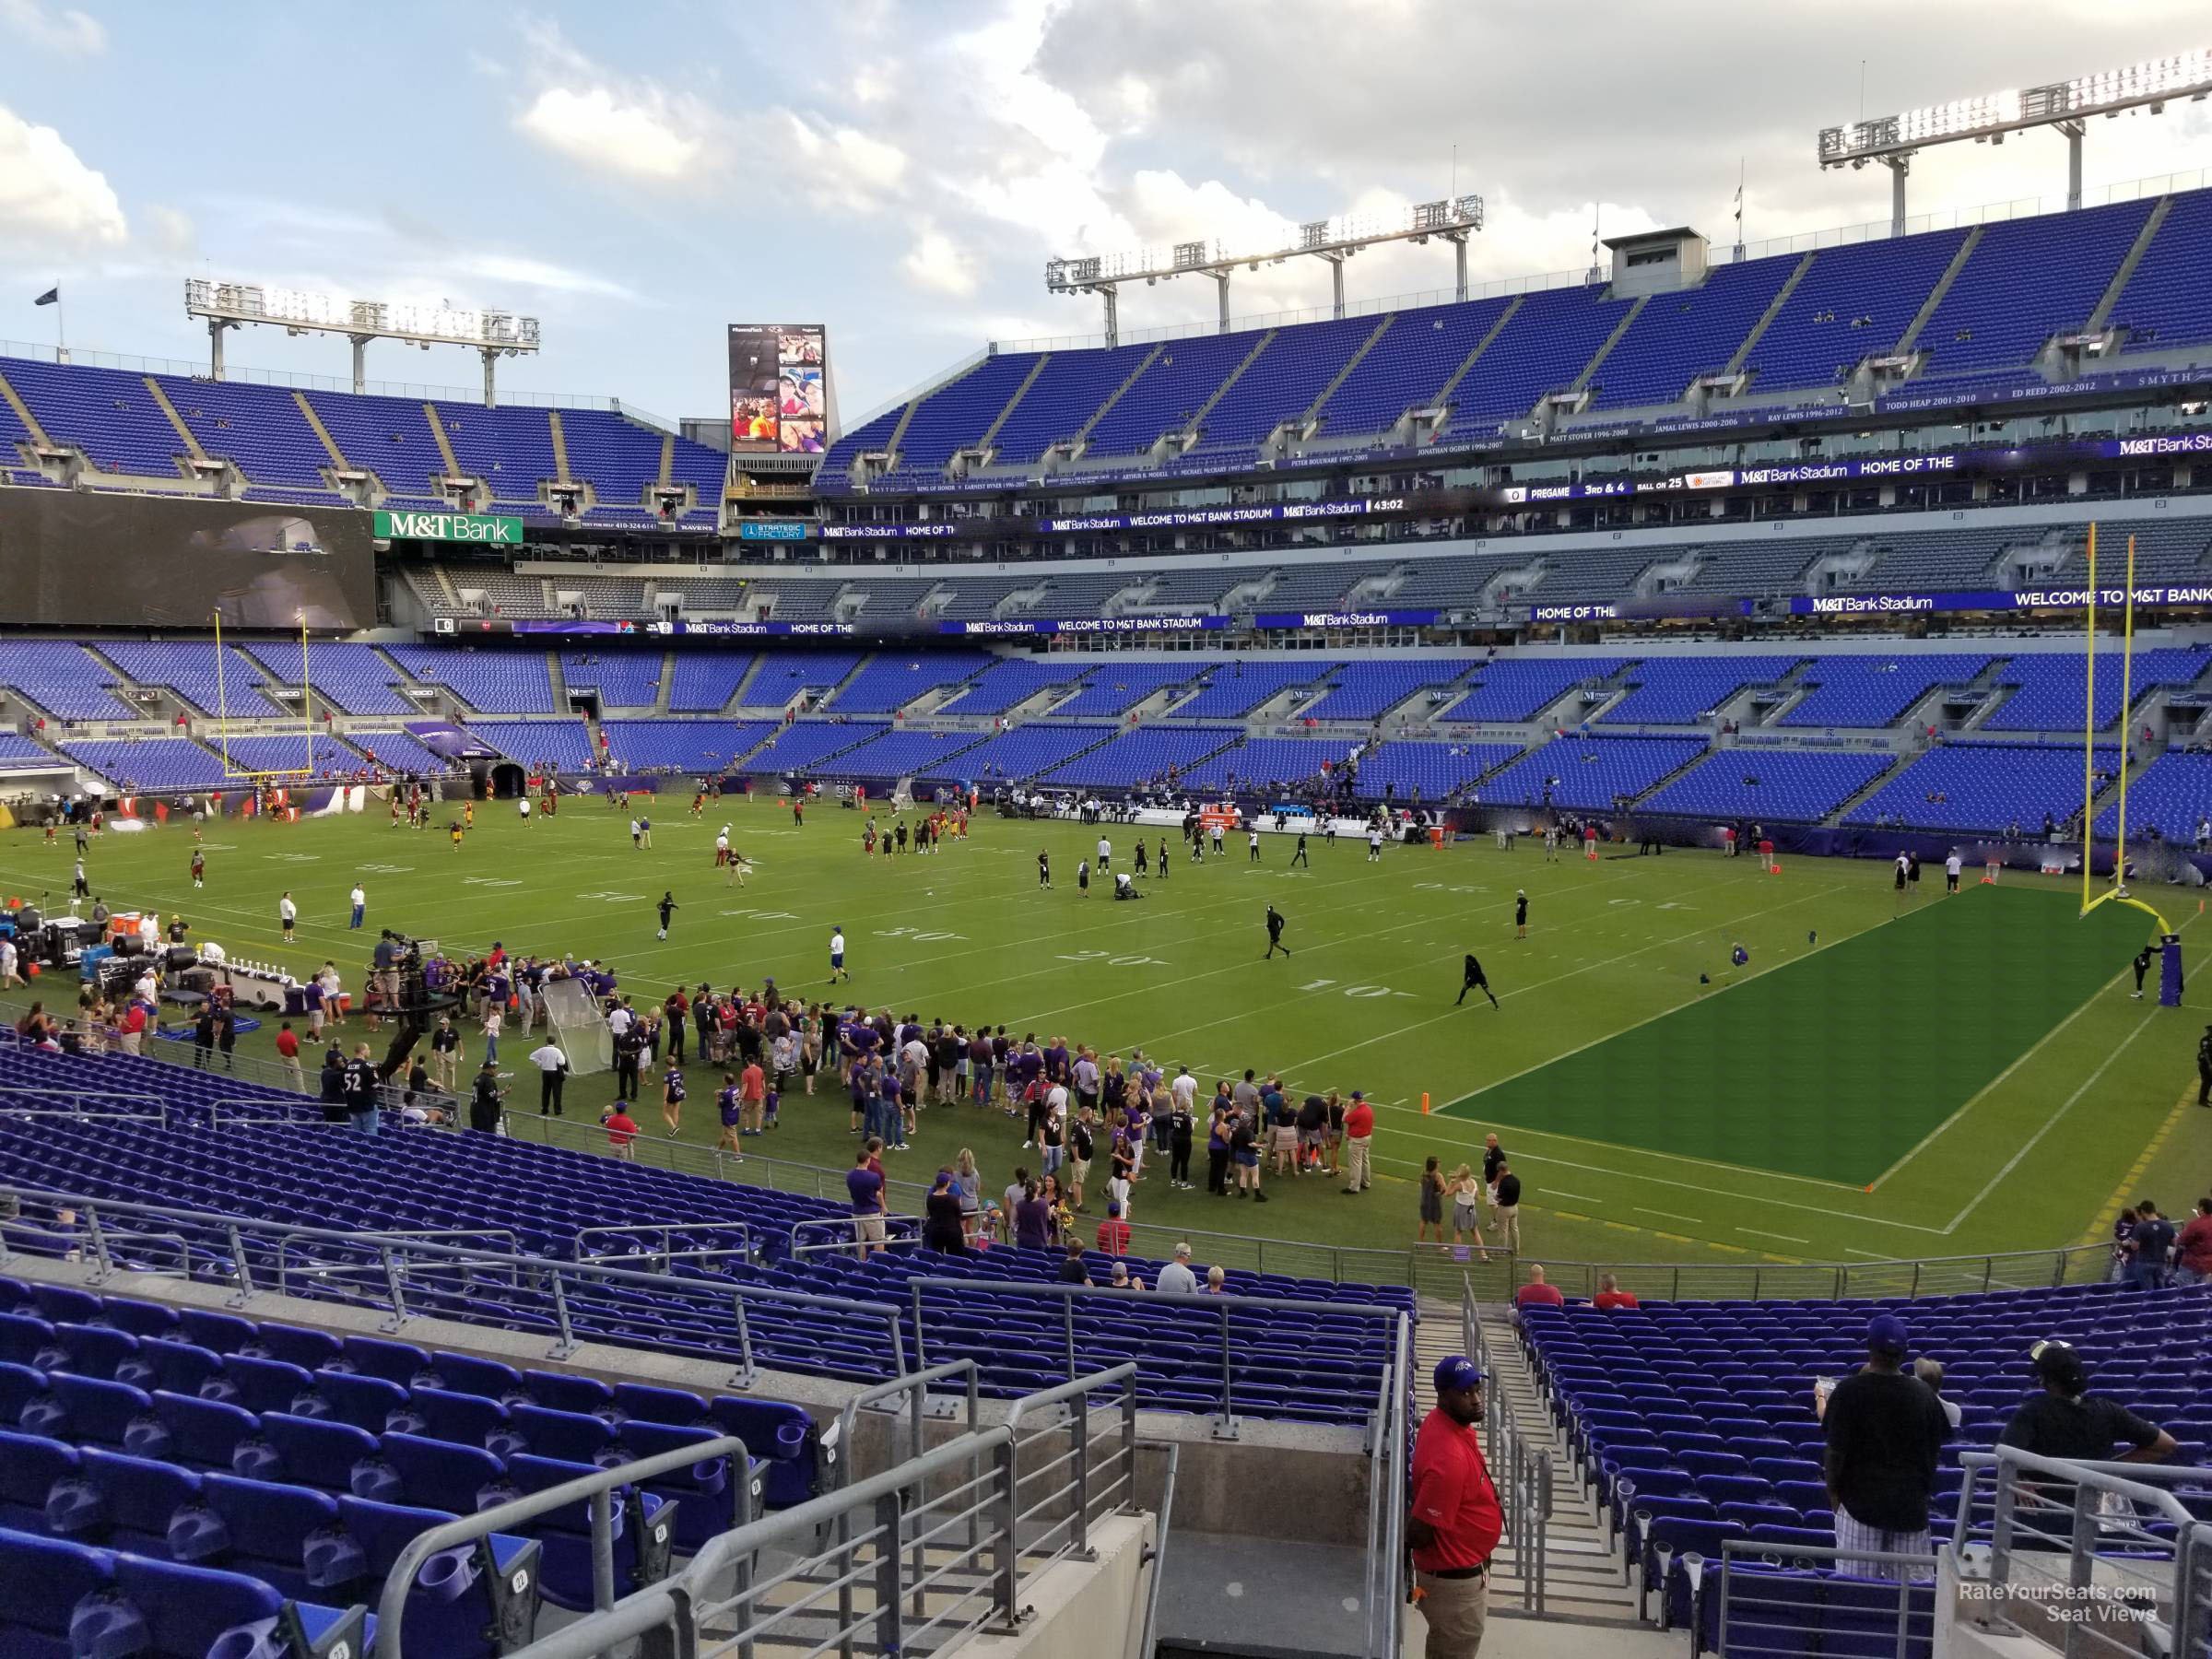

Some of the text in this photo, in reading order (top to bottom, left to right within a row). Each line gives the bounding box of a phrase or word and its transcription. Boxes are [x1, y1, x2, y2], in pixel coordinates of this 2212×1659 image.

[2012, 382, 2096, 397] ED REED 2002-2012
[1887, 394, 1976, 410] TODD HEAP 2001-2010
[1783, 412, 1804, 420] LEWIS
[1806, 407, 1842, 418] 1996-2012
[1654, 418, 1737, 432] JAMAL LEWIS 2000-2006
[1550, 434, 1567, 442] MATT
[1568, 432, 1592, 441] STOVER
[1418, 448, 1448, 456] JONATHAN
[1449, 445, 1470, 453] OGDEN
[2120, 438, 2157, 455] M&T
[2158, 436, 2194, 452] Bank
[1861, 455, 1955, 475] HOME OF THE
[1741, 470, 1771, 484] M&T
[1771, 467, 1798, 481] Bank
[1800, 465, 1847, 479] Stadium
[1606, 483, 1614, 493] &
[1617, 482, 1624, 492] 4
[1668, 478, 1682, 488] 25
[1531, 487, 1570, 500] PREGAME
[1283, 502, 1360, 517] M&T Bank Stadium
[1373, 500, 1404, 511] 43:02
[1053, 518, 1120, 530] M&T Bank Stadium
[1130, 509, 1272, 526] WELCOME TO M&T BANK STADIUM
[389, 512, 510, 541] M&T Bank
[824, 526, 898, 536] M&T Bank Stadium
[906, 526, 931, 535] HOME
[933, 525, 945, 535] OF
[2015, 588, 2212, 605] WELCOME TO M&T BANK
[1813, 595, 1933, 612] M&T Bank Stadium
[1536, 606, 1571, 619] HOME
[1573, 606, 1591, 618] OF
[1058, 618, 1202, 630] WELCOME TO M&T BANK STADIUM
[1304, 613, 1388, 626] M&T Bank Stadium
[686, 623, 767, 634] M&T Bank Stadium
[791, 624, 819, 633] HOME
[820, 624, 833, 633] OF
[966, 621, 1034, 632] M&T Bank Stadium
[344, 1074, 362, 1091] 52
[657, 1527, 665, 1541] 21
[516, 1572, 526, 1589] 22
